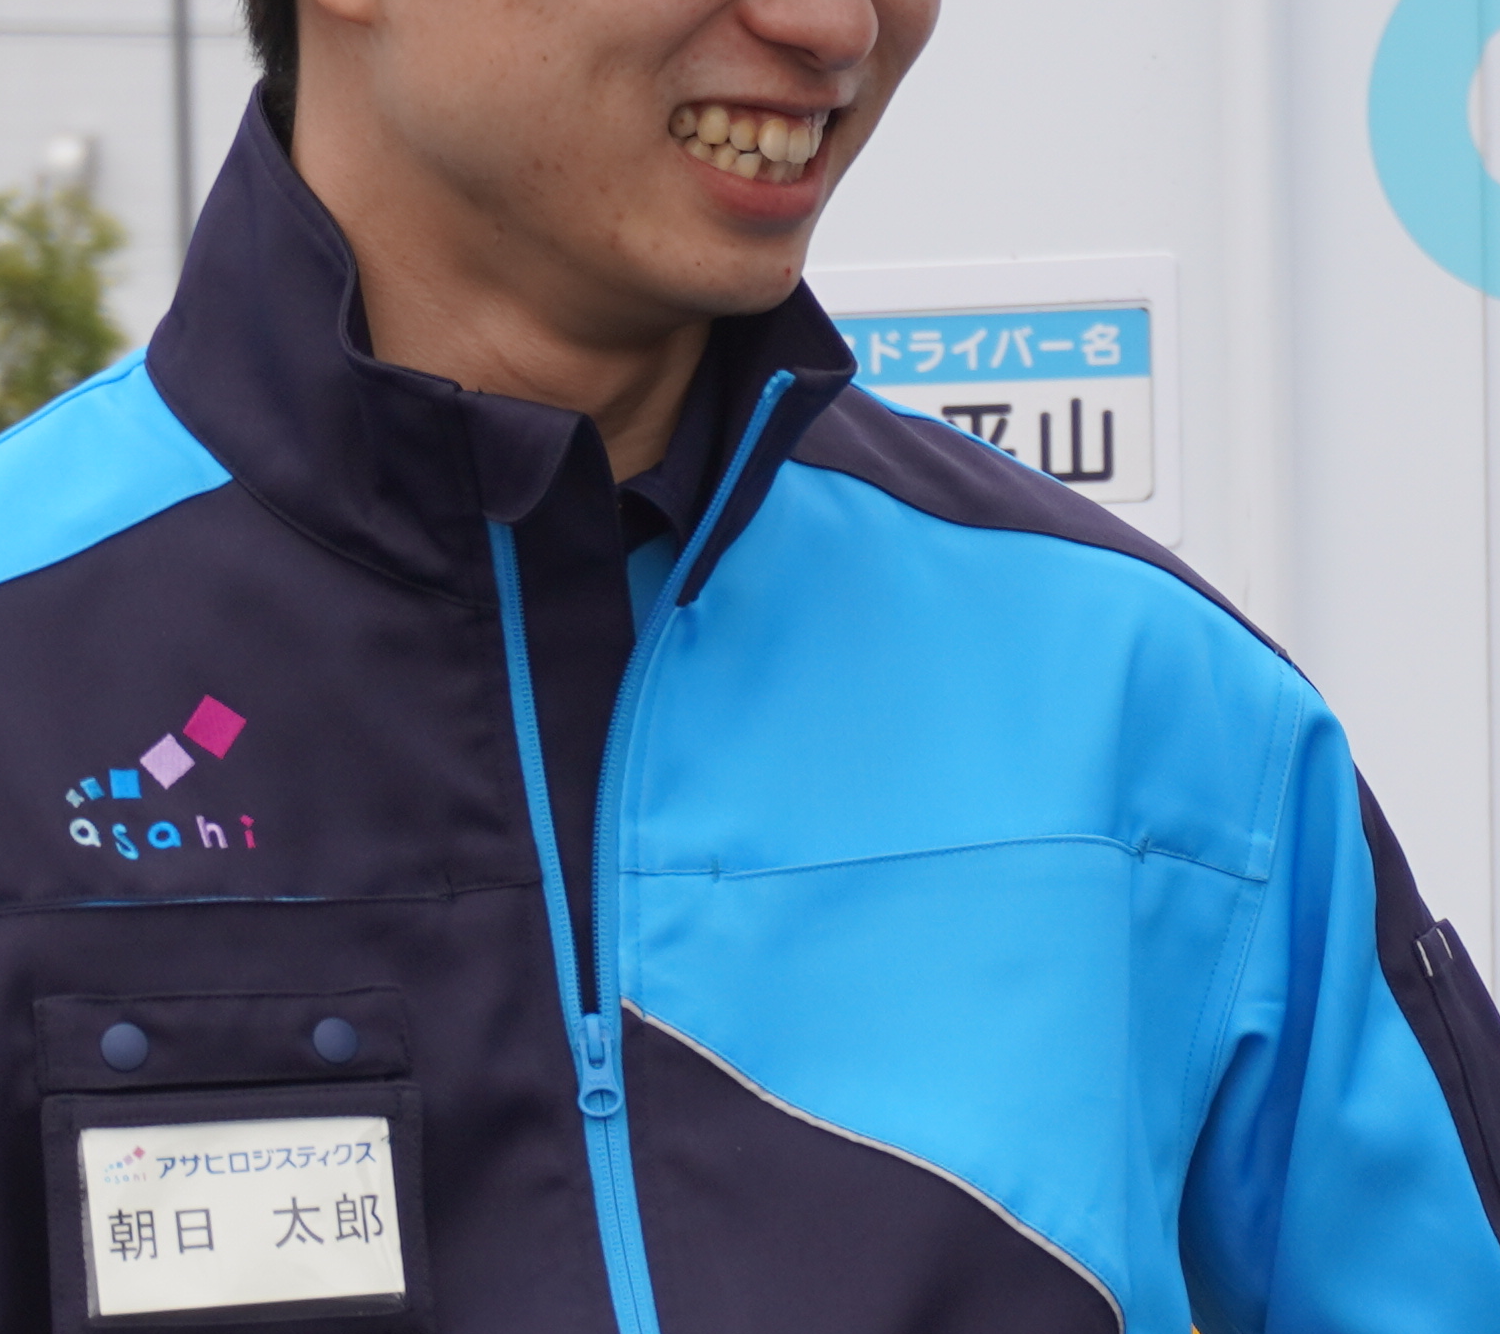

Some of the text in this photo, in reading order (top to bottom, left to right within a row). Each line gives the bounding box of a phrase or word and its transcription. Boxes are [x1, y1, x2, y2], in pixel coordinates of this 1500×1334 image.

[841, 323, 1122, 374] ドライバー名
[69, 815, 257, 861] asahi
[155, 1141, 377, 1180] アサヒロジスティクス
